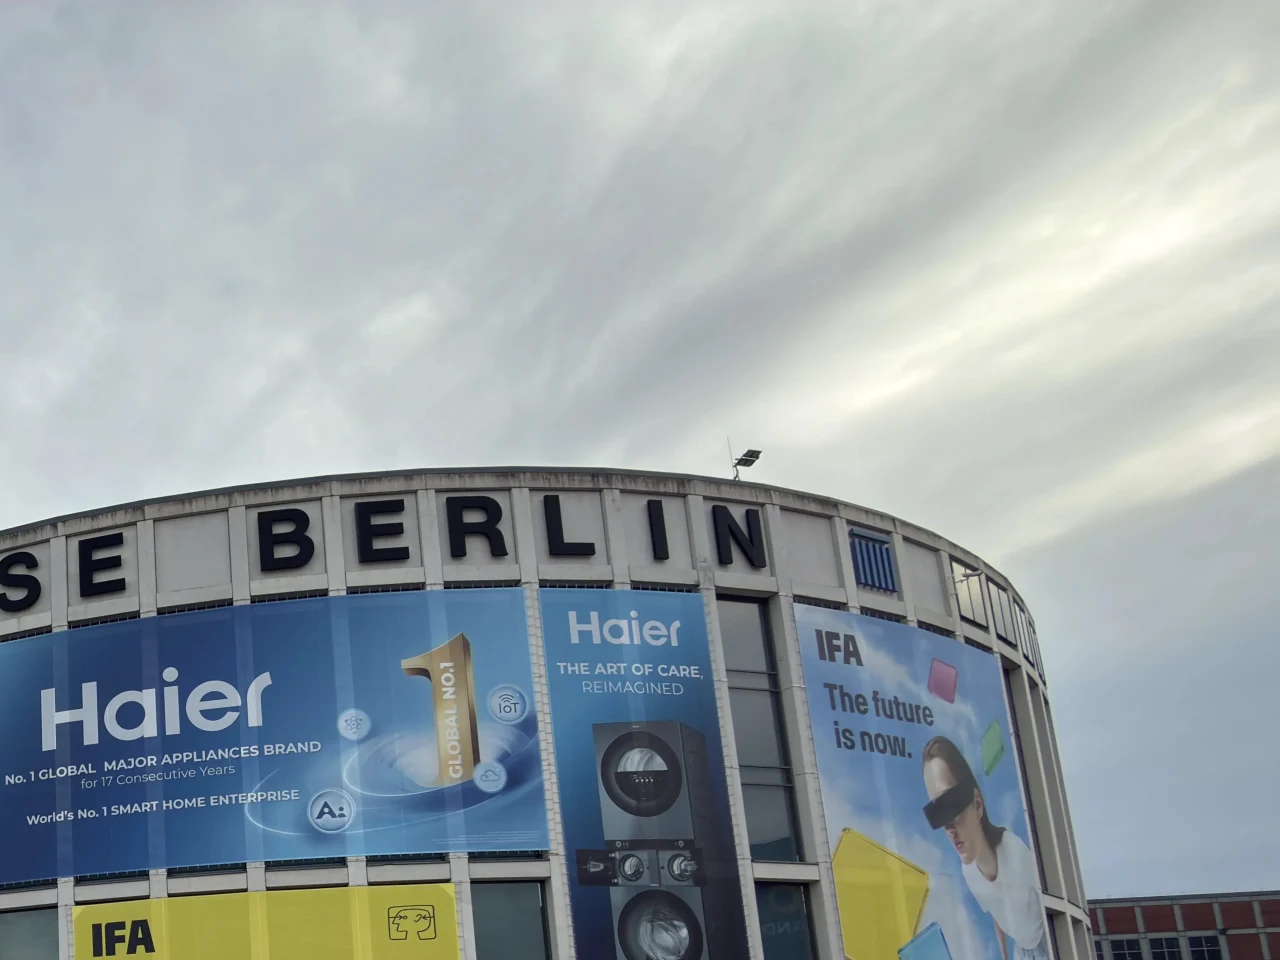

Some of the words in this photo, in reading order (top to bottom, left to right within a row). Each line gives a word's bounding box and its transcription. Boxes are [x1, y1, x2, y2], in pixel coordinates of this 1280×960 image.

[257, 493, 767, 572] BERLIN
[568, 610, 681, 647] Haier
[815, 628, 864, 667] IFA
[440, 661, 457, 699] NO.1
[556, 662, 590, 675] THE
[595, 662, 627, 675] ART
[631, 663, 654, 676] OF
[657, 664, 704, 680] CARE,
[582, 680, 684, 695] REIMAGINED
[40, 666, 273, 752] Haier
[499, 702, 520, 714] IoT
[823, 682, 869, 715] The
[872, 690, 934, 727] future
[444, 708, 463, 779] GLOBAL
[833, 720, 856, 750] is
[859, 730, 912, 759] now.
[5, 774, 27, 786] No.
[29, 771, 35, 782] 1
[38, 763, 97, 780] GLOBAL
[104, 755, 157, 772] MAJOR
[161, 745, 260, 765] APPLIANCES
[264, 741, 322, 756] BRAND
[80, 778, 98, 790] for
[101, 776, 113, 787] 17
[116, 768, 197, 785] Consecutive
[199, 764, 236, 777] Years
[26, 810, 74, 826] World's
[77, 808, 99, 819] No.
[102, 806, 108, 817] 1
[111, 801, 159, 816] SMART
[162, 796, 206, 811] HOME
[210, 789, 300, 807] ENTERPRISE
[91, 918, 156, 958] IFA
